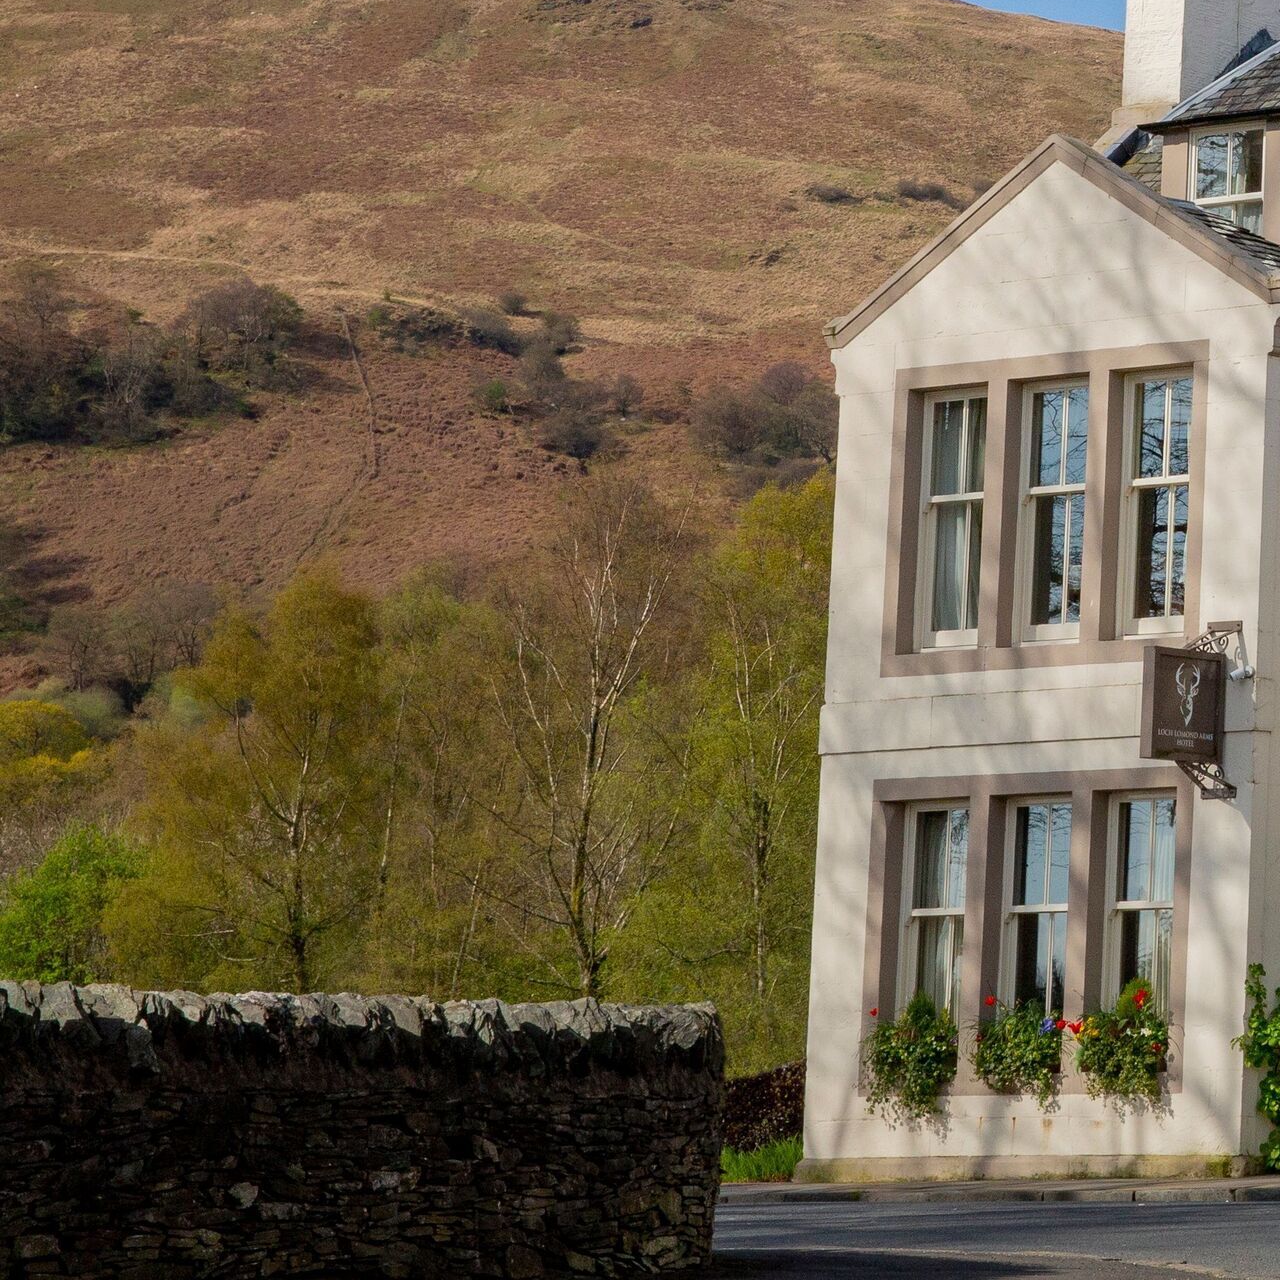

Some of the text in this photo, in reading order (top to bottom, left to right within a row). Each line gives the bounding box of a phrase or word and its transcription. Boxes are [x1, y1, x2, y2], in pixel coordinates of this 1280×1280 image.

[1158, 728, 1173, 736] LOCH
[1174, 730, 1198, 739] LOMOND
[1177, 739, 1194, 747] HOTEL
